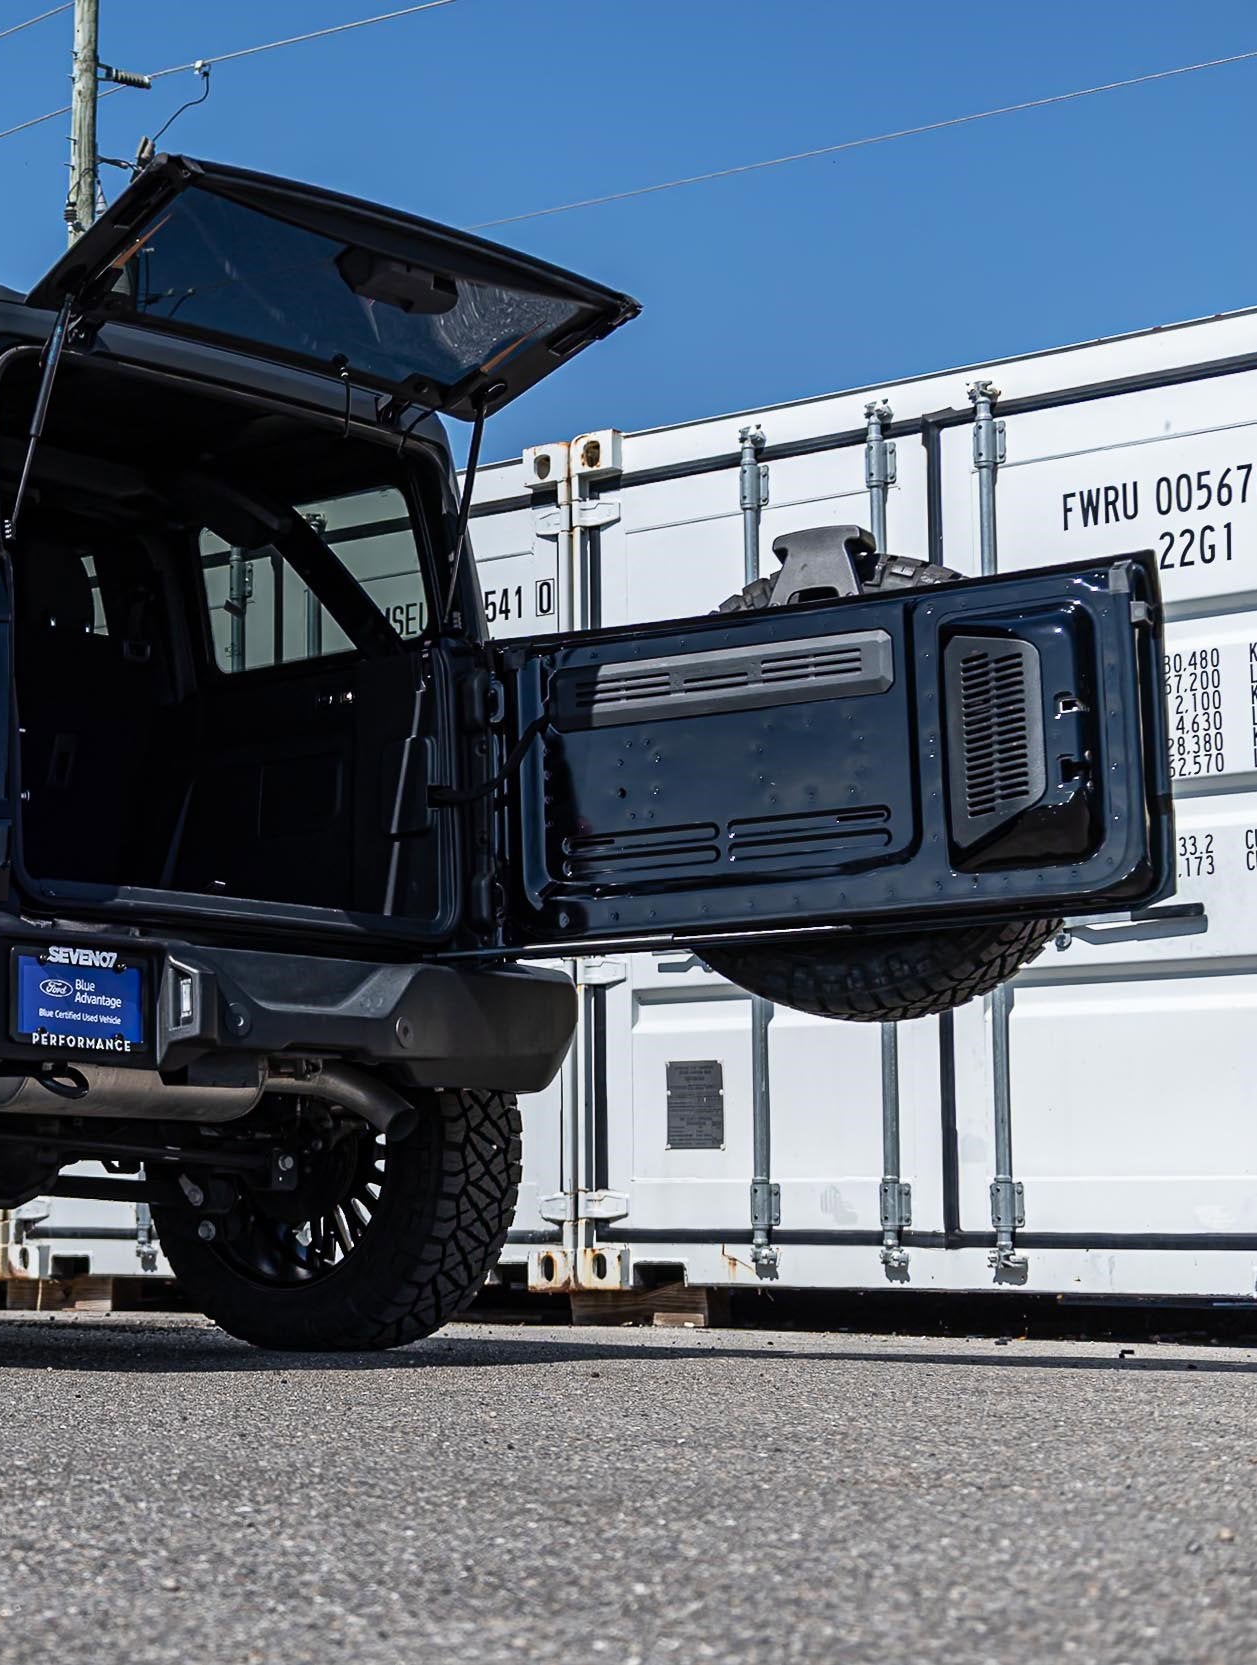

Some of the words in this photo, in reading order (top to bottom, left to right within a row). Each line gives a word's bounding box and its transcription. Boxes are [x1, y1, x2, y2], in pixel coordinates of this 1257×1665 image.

[1062, 481, 1139, 531] FWRU
[1155, 463, 1253, 515] 00567
[1159, 522, 1232, 570] 22G1
[485, 586, 522, 622] 541
[1178, 834, 1214, 856] 33.2
[46, 981, 67, 994] Ford
[75, 979, 95, 991] Blue
[74, 992, 122, 1009] Advantage
[39, 1008, 54, 1017] Blue
[55, 1010, 81, 1020] Certified
[82, 1013, 98, 1022] Used
[99, 1015, 121, 1024] Vehicle
[32, 1032, 131, 1052] PERFORMANCE
